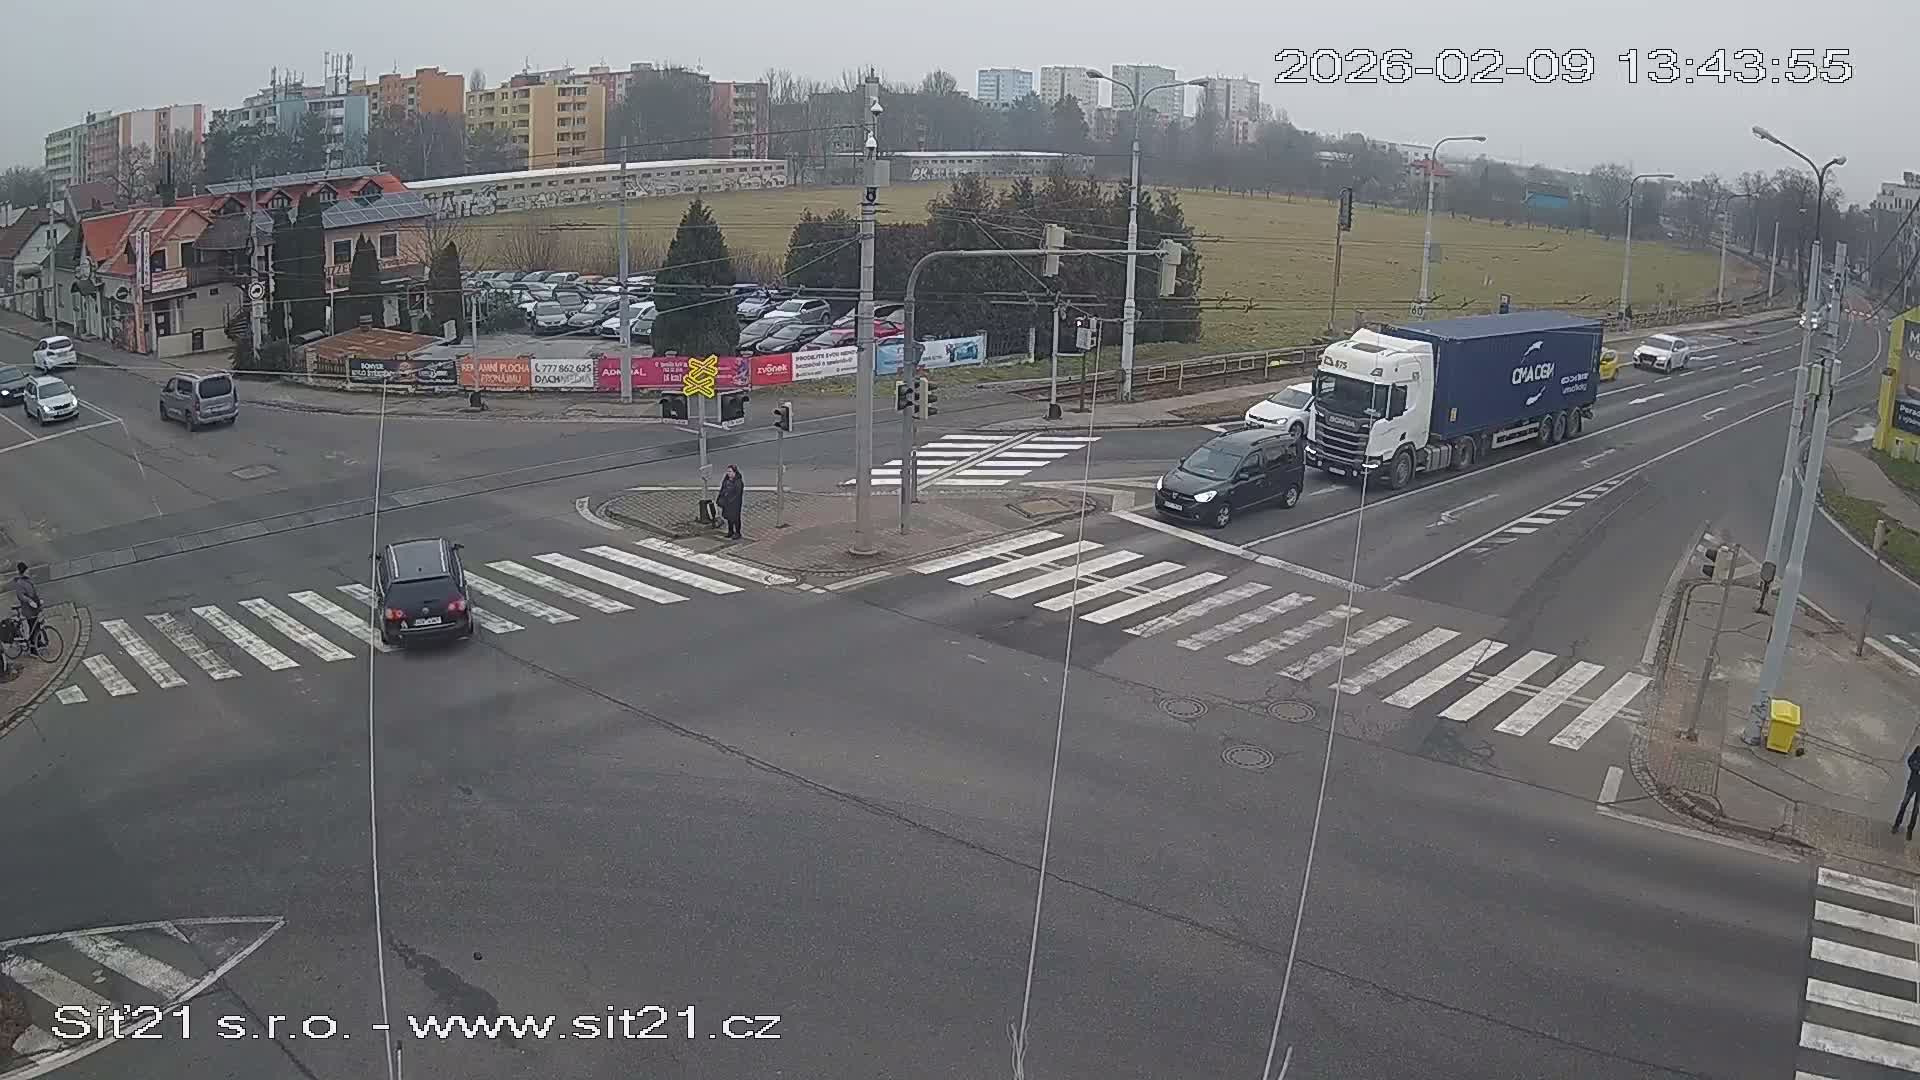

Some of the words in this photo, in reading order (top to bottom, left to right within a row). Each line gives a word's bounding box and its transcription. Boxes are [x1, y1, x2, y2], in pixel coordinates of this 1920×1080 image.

[1411, 303, 1424, 316] 60
[499, 363, 530, 373] PLOCHA
[541, 364, 558, 373] 777
[558, 364, 575, 373] 862
[575, 363, 592, 373] 625
